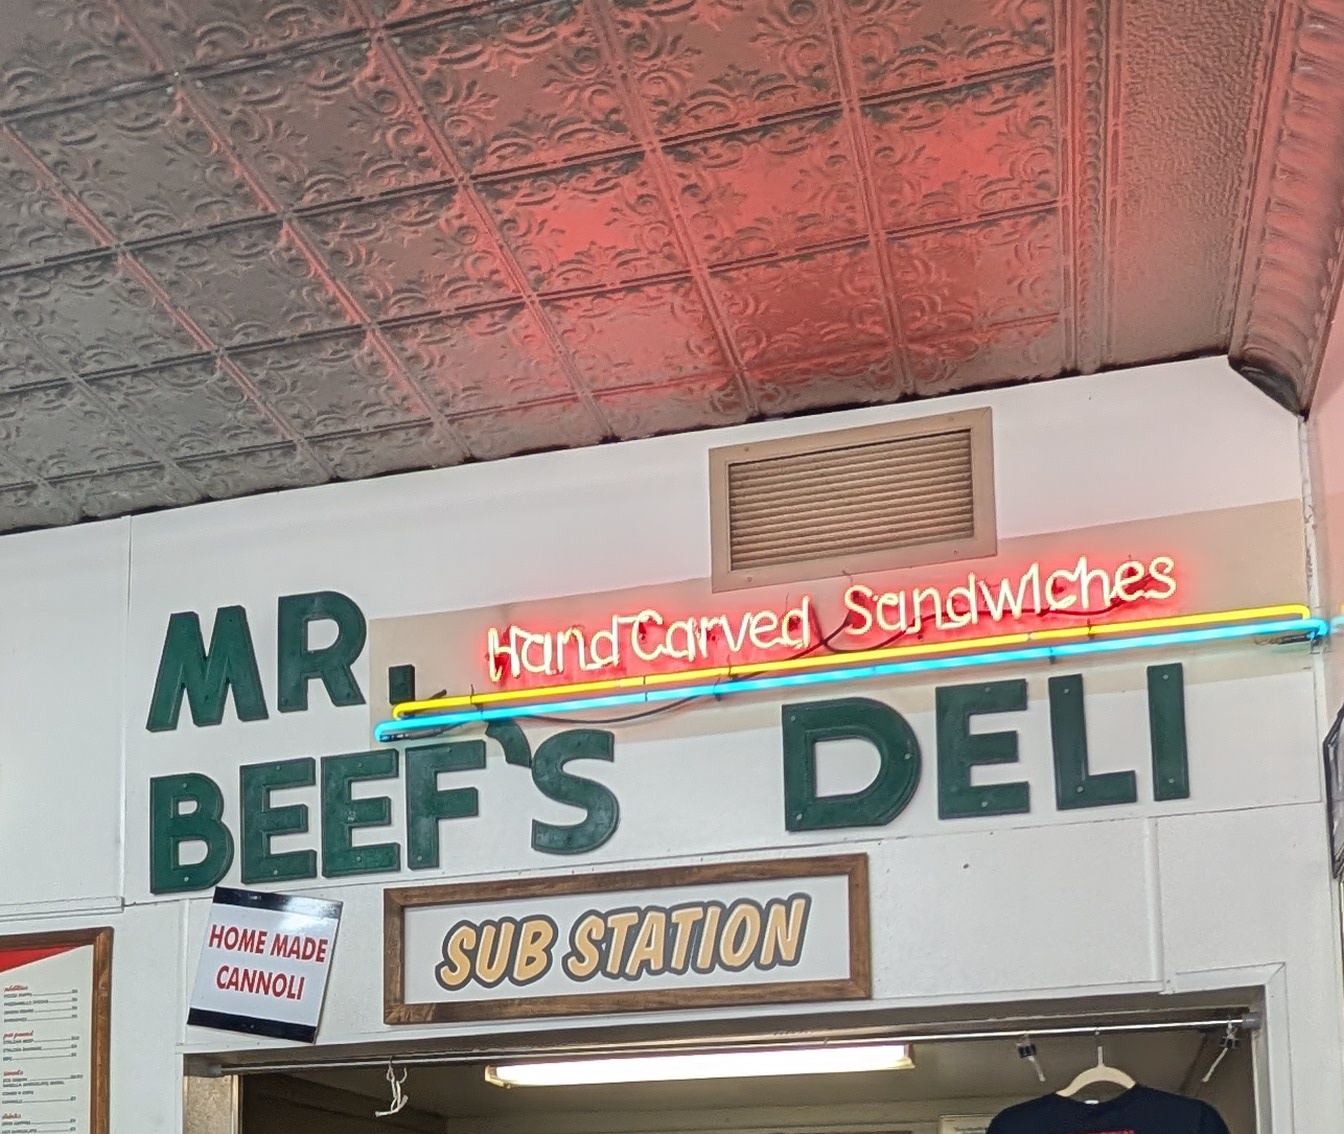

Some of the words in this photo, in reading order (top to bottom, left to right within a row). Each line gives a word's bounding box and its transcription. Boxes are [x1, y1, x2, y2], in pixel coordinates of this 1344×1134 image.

[145, 590, 416, 733] MR.
[488, 613, 619, 682] Hand
[620, 596, 812, 662] Carved
[843, 556, 1177, 634] Sandwiches
[149, 718, 620, 895] BEEF'S
[782, 662, 1190, 832] DELI
[208, 923, 268, 954] HOME
[270, 932, 329, 963] MADE
[216, 965, 305, 1000] CANNOLI
[438, 917, 553, 990] SUB
[565, 893, 812, 982] STATION
